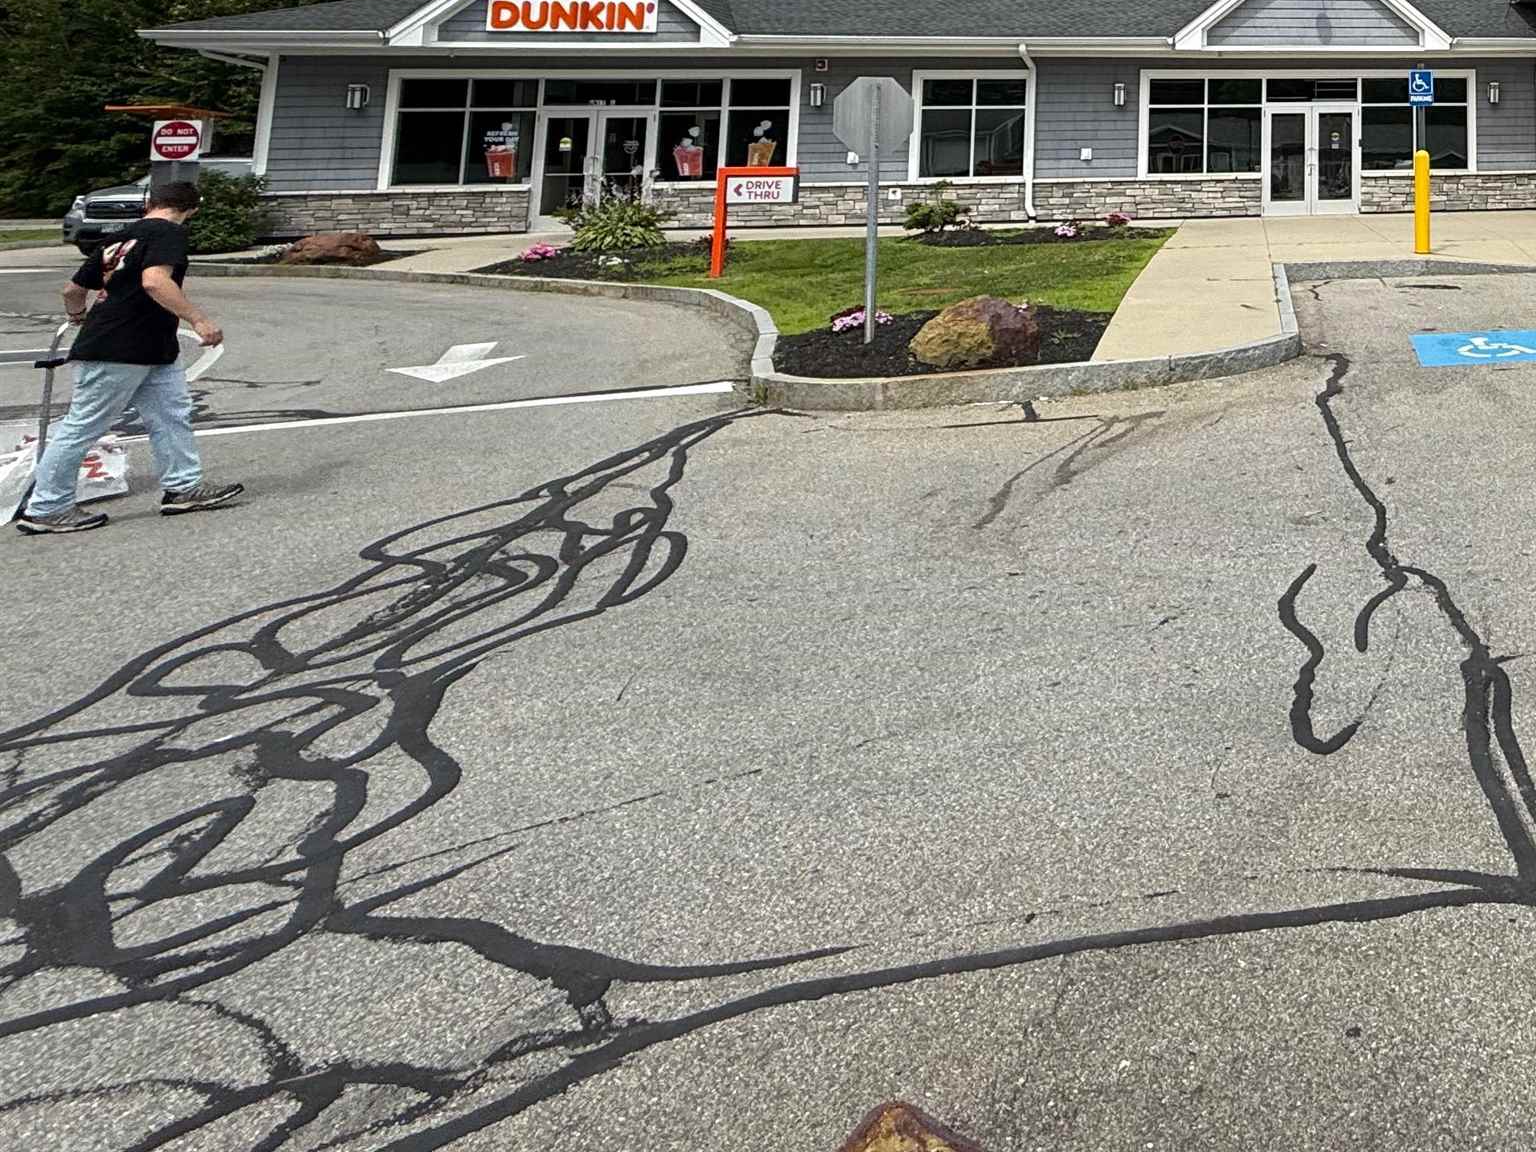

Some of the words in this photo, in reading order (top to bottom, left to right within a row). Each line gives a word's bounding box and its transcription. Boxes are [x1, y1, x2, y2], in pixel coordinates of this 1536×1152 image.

[490, 0, 655, 30] DUNKIN'
[746, 180, 782, 189] DRIVE
[747, 190, 780, 199] THRU
